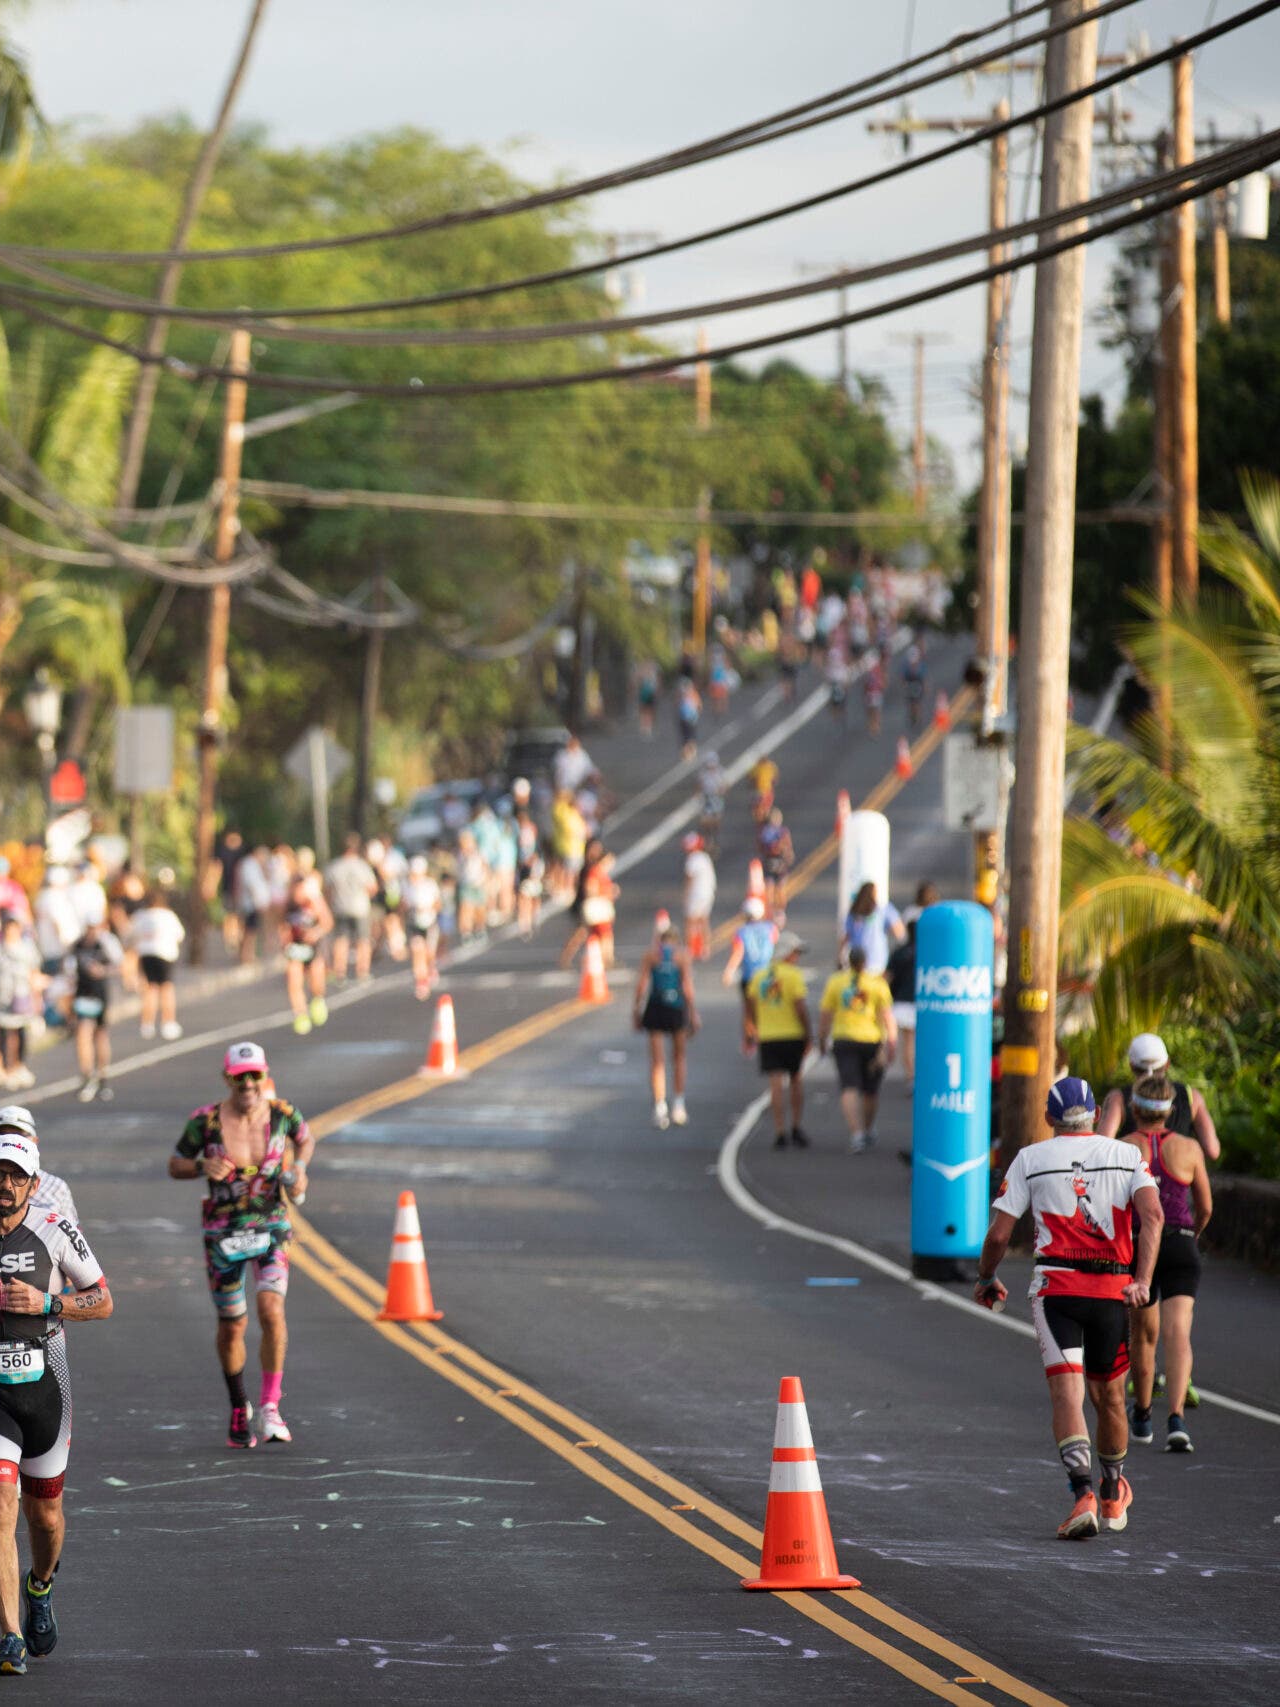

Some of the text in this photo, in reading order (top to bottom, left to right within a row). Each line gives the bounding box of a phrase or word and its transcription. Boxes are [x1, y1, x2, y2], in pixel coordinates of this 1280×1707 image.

[916, 965, 991, 998] HOKA
[945, 1053, 961, 1089] 1
[930, 1089, 976, 1114] MILE
[57, 1219, 89, 1262] BASE
